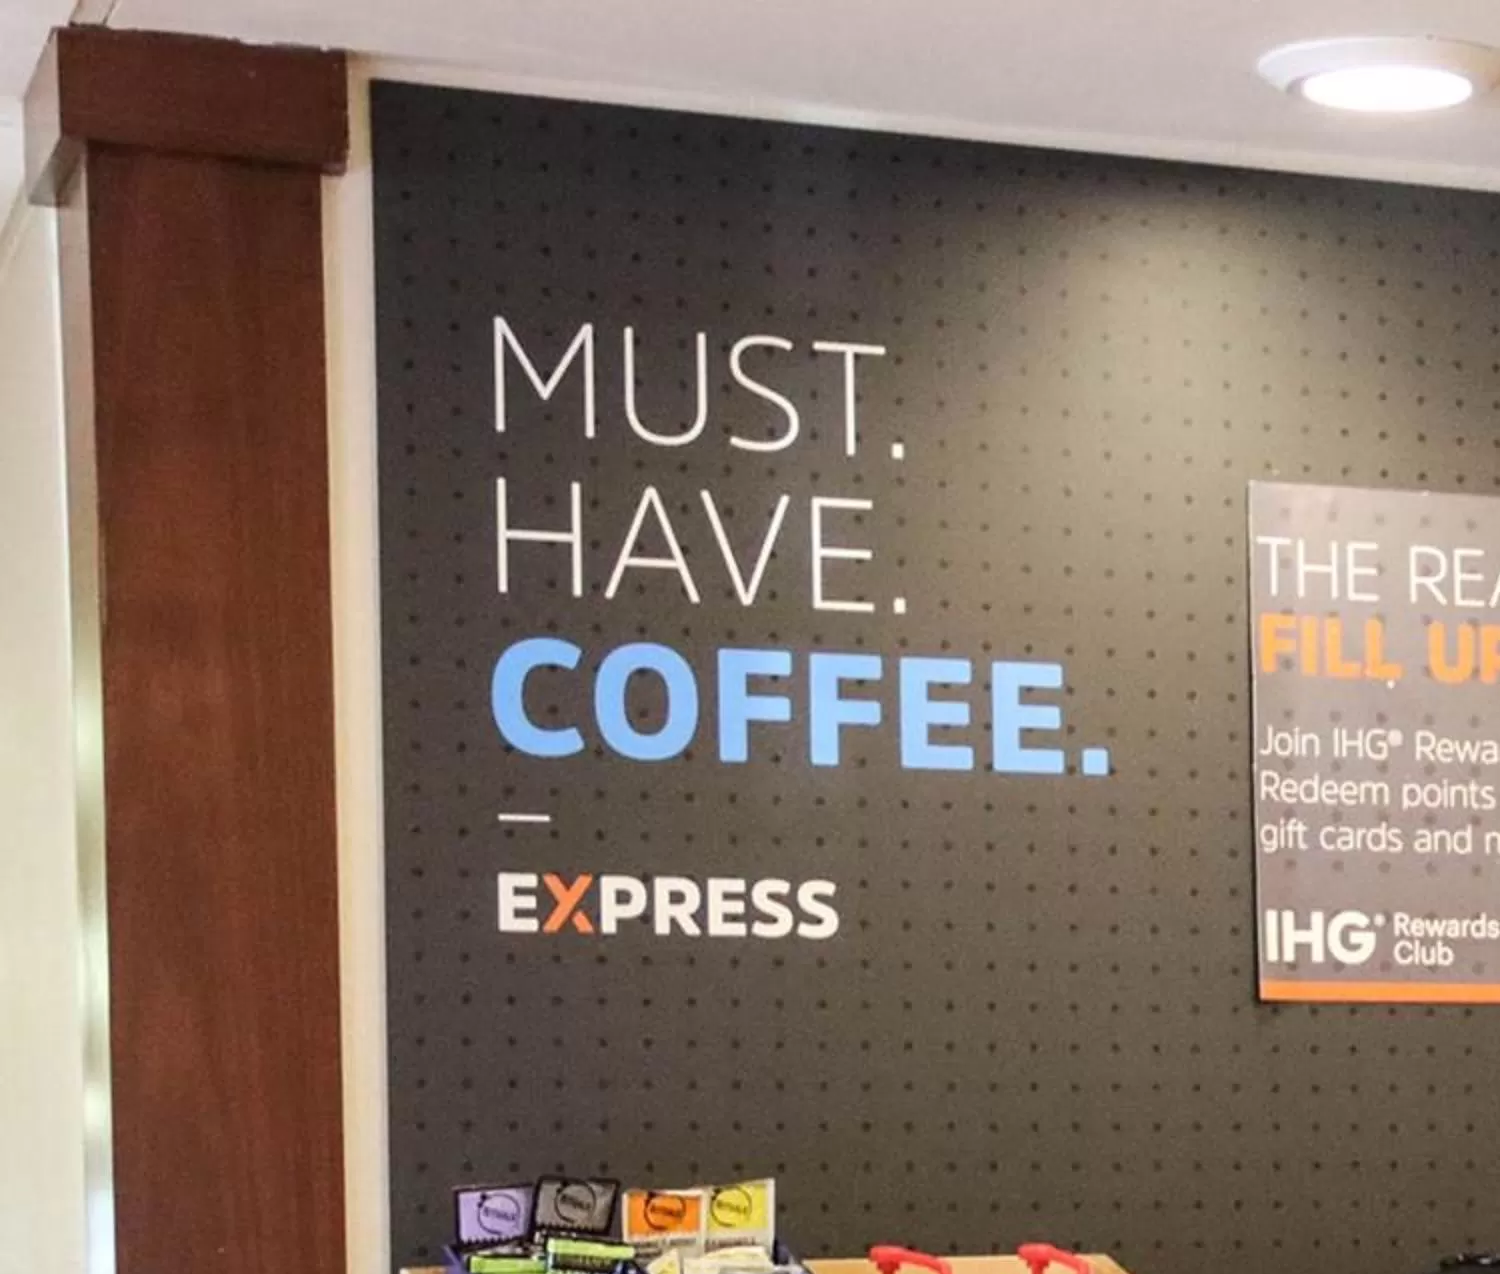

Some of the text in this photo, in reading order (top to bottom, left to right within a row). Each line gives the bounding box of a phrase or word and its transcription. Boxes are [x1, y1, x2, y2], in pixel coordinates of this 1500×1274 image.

[494, 315, 904, 459] MUST.
[497, 477, 906, 614] HAVE.
[1256, 536, 1380, 602] THE
[1258, 611, 1405, 681] FILL
[490, 637, 1111, 776] COFFEE.
[1260, 724, 1320, 757] Join
[1260, 770, 1390, 805] Redeem
[1402, 778, 1497, 811] points
[1260, 817, 1308, 853] gift
[1319, 821, 1403, 852] cards
[1413, 824, 1473, 855] and
[497, 872, 840, 940] EXPRESS
[1264, 908, 1500, 965] IHG Rewards
[1393, 940, 1454, 966] Club
